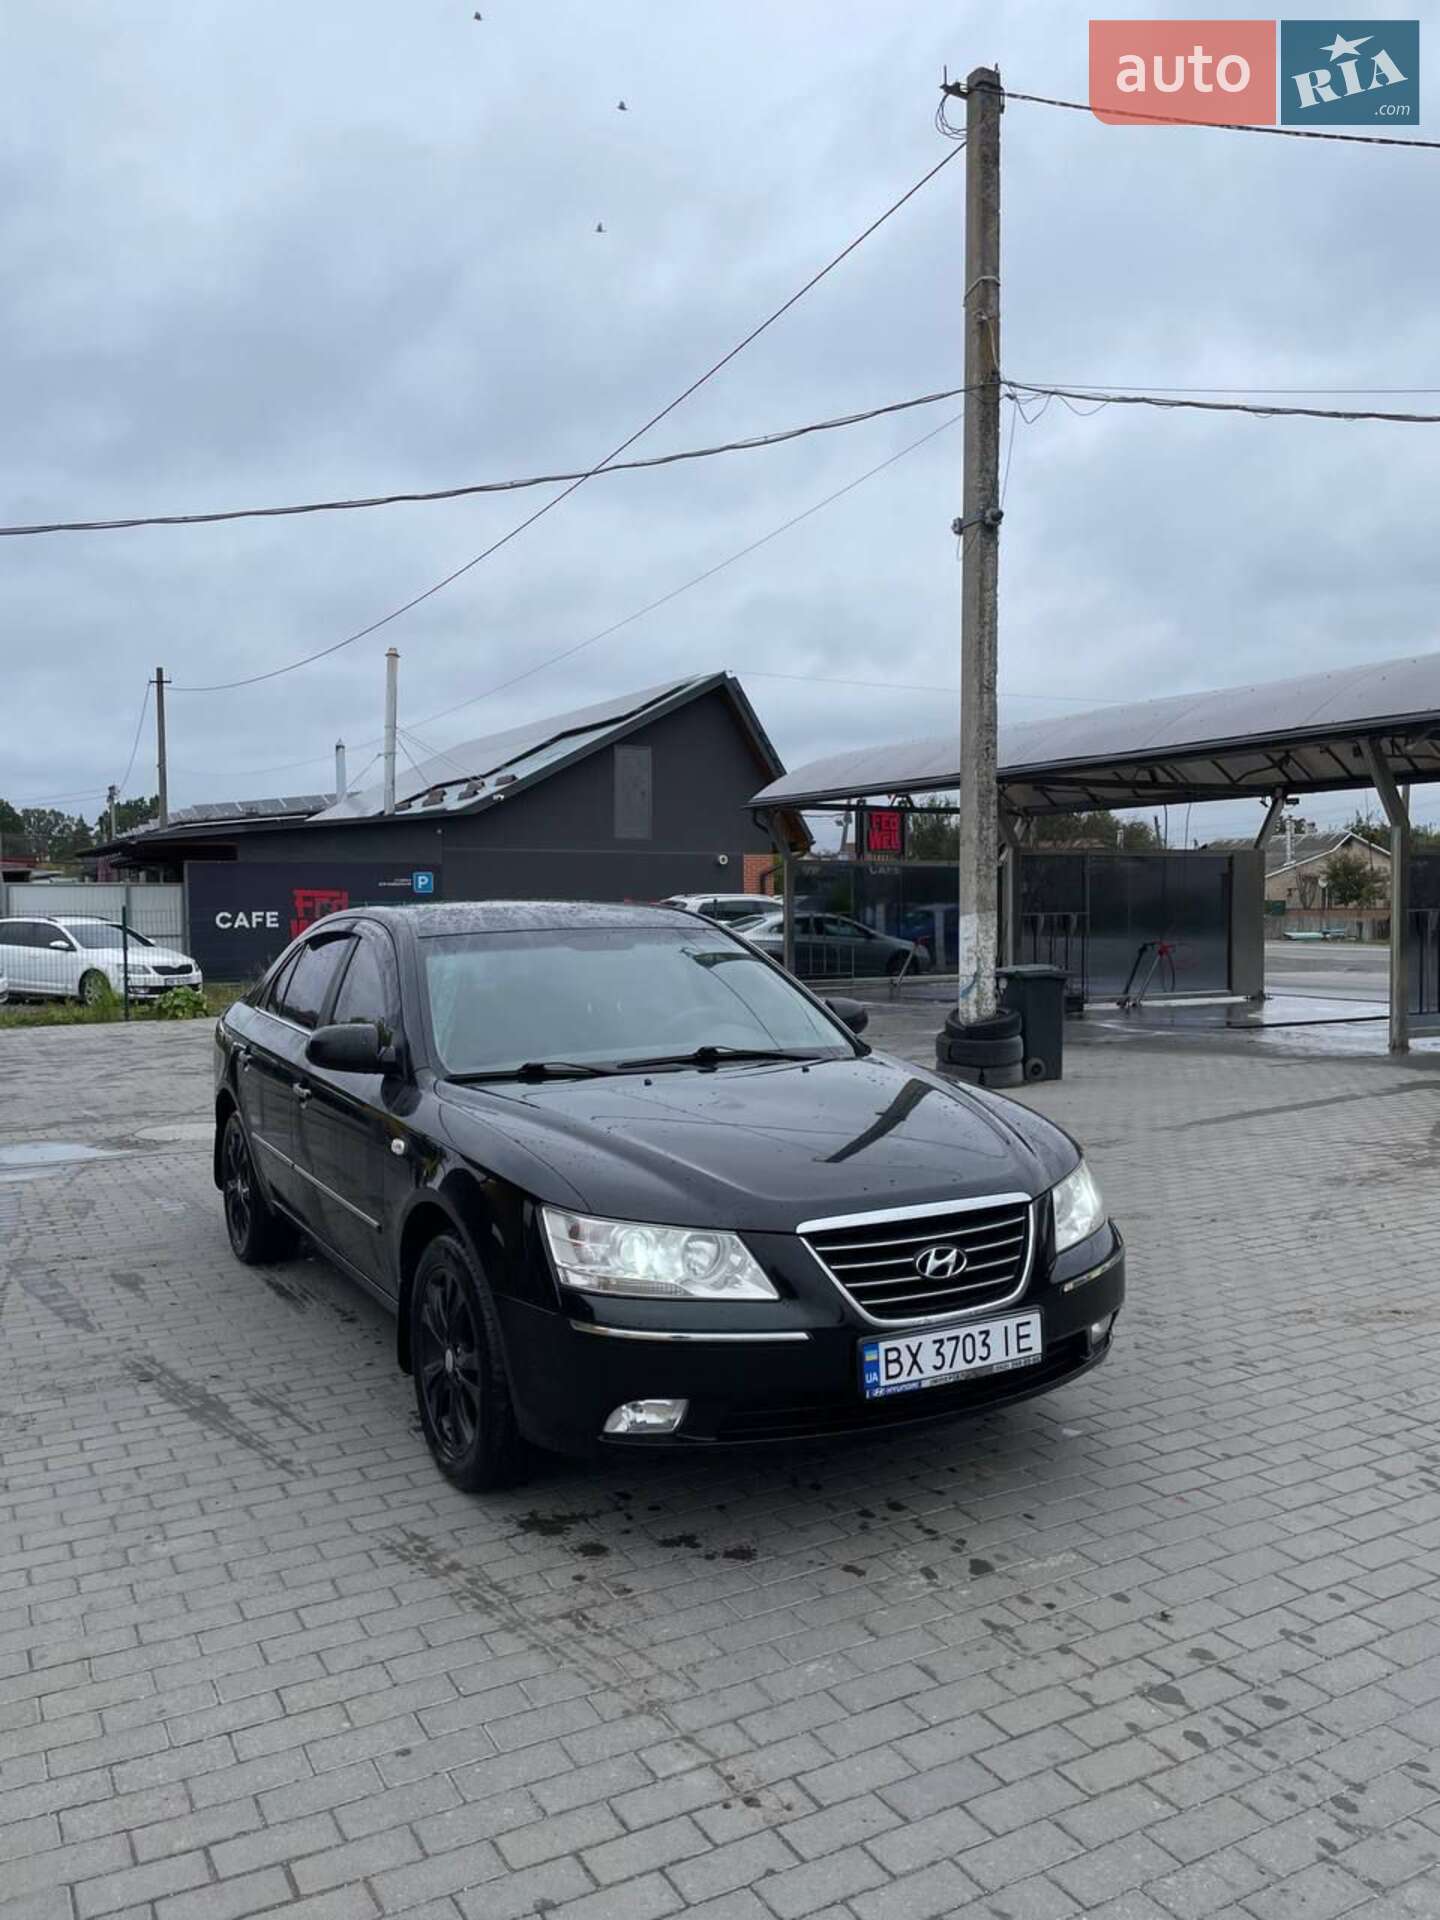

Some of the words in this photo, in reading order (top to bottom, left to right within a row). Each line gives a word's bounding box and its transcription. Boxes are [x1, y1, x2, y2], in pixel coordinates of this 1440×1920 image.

[418, 876, 429, 888] P
[215, 911, 279, 929] CAFE
[884, 1342, 924, 1380] BX
[932, 1329, 991, 1371] 3703
[1003, 1321, 1033, 1357] IE
[865, 1373, 878, 1383] UA
